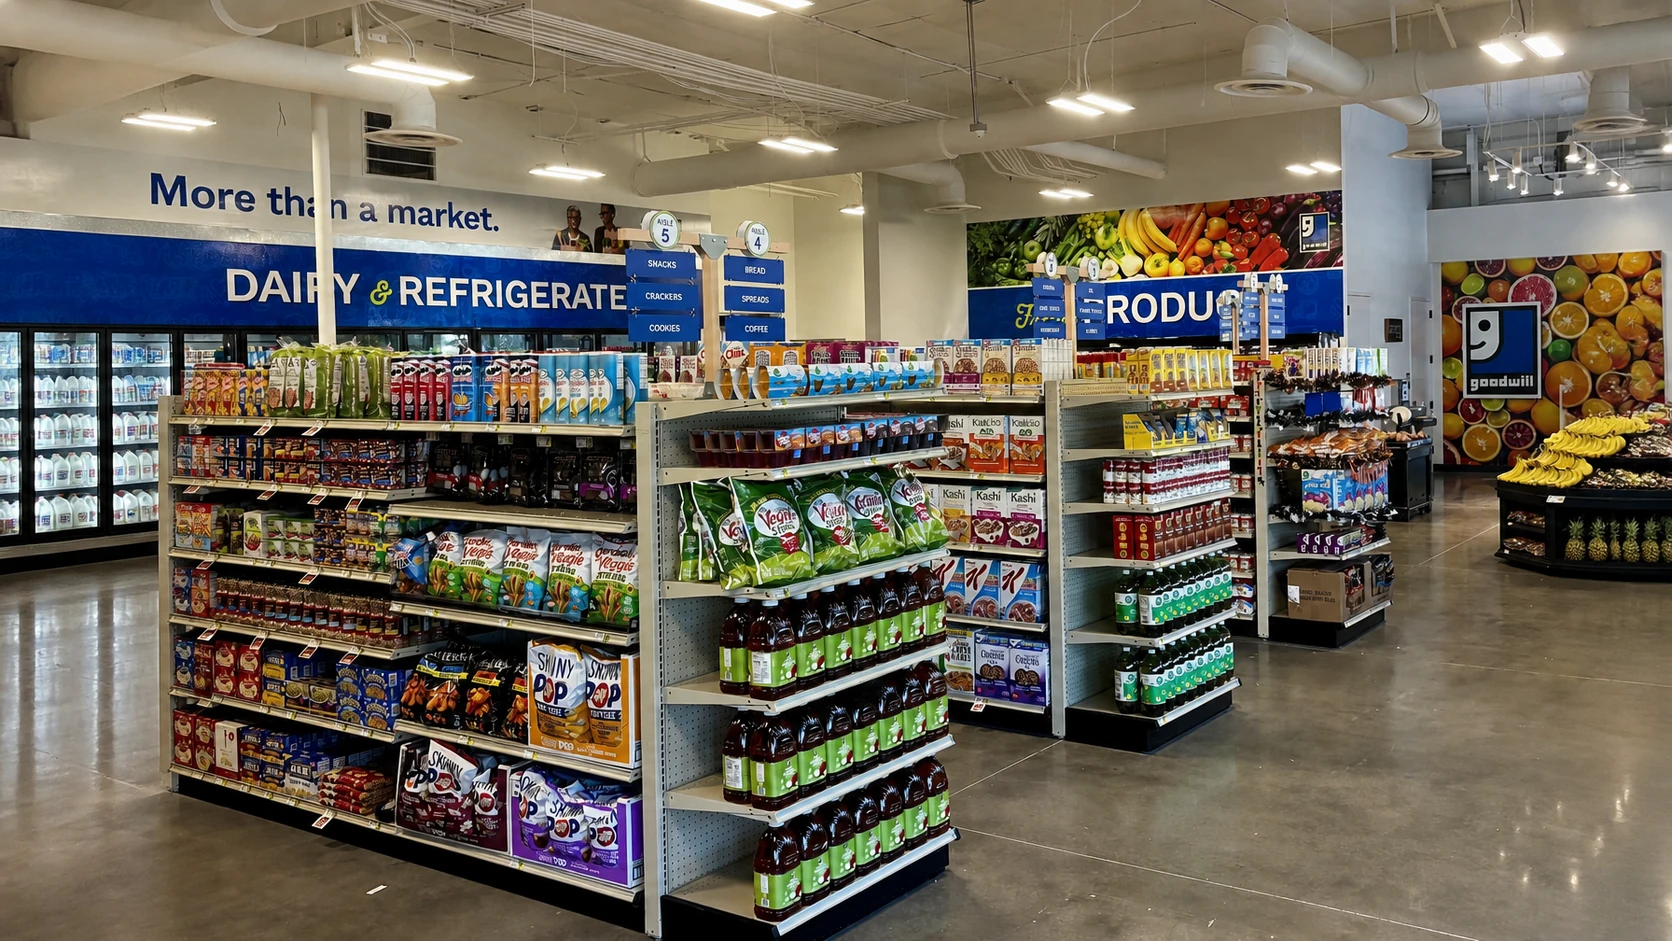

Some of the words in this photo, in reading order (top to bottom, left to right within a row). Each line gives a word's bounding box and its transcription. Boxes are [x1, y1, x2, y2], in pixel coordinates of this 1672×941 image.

[150, 172, 256, 213] More
[359, 202, 378, 223] a
[388, 202, 499, 232] market.
[661, 228, 670, 243] 5
[754, 236, 762, 250] 4
[744, 266, 766, 275] BREAD
[369, 279, 393, 306] &
[645, 292, 683, 301] CRACKERS
[741, 294, 770, 304] SPREADS
[648, 323, 681, 333] COOKIES
[744, 324, 769, 333] COFFEE
[942, 488, 966, 500] Kashi
[976, 490, 1001, 502] Kashi
[1010, 492, 1037, 504] Kashi
